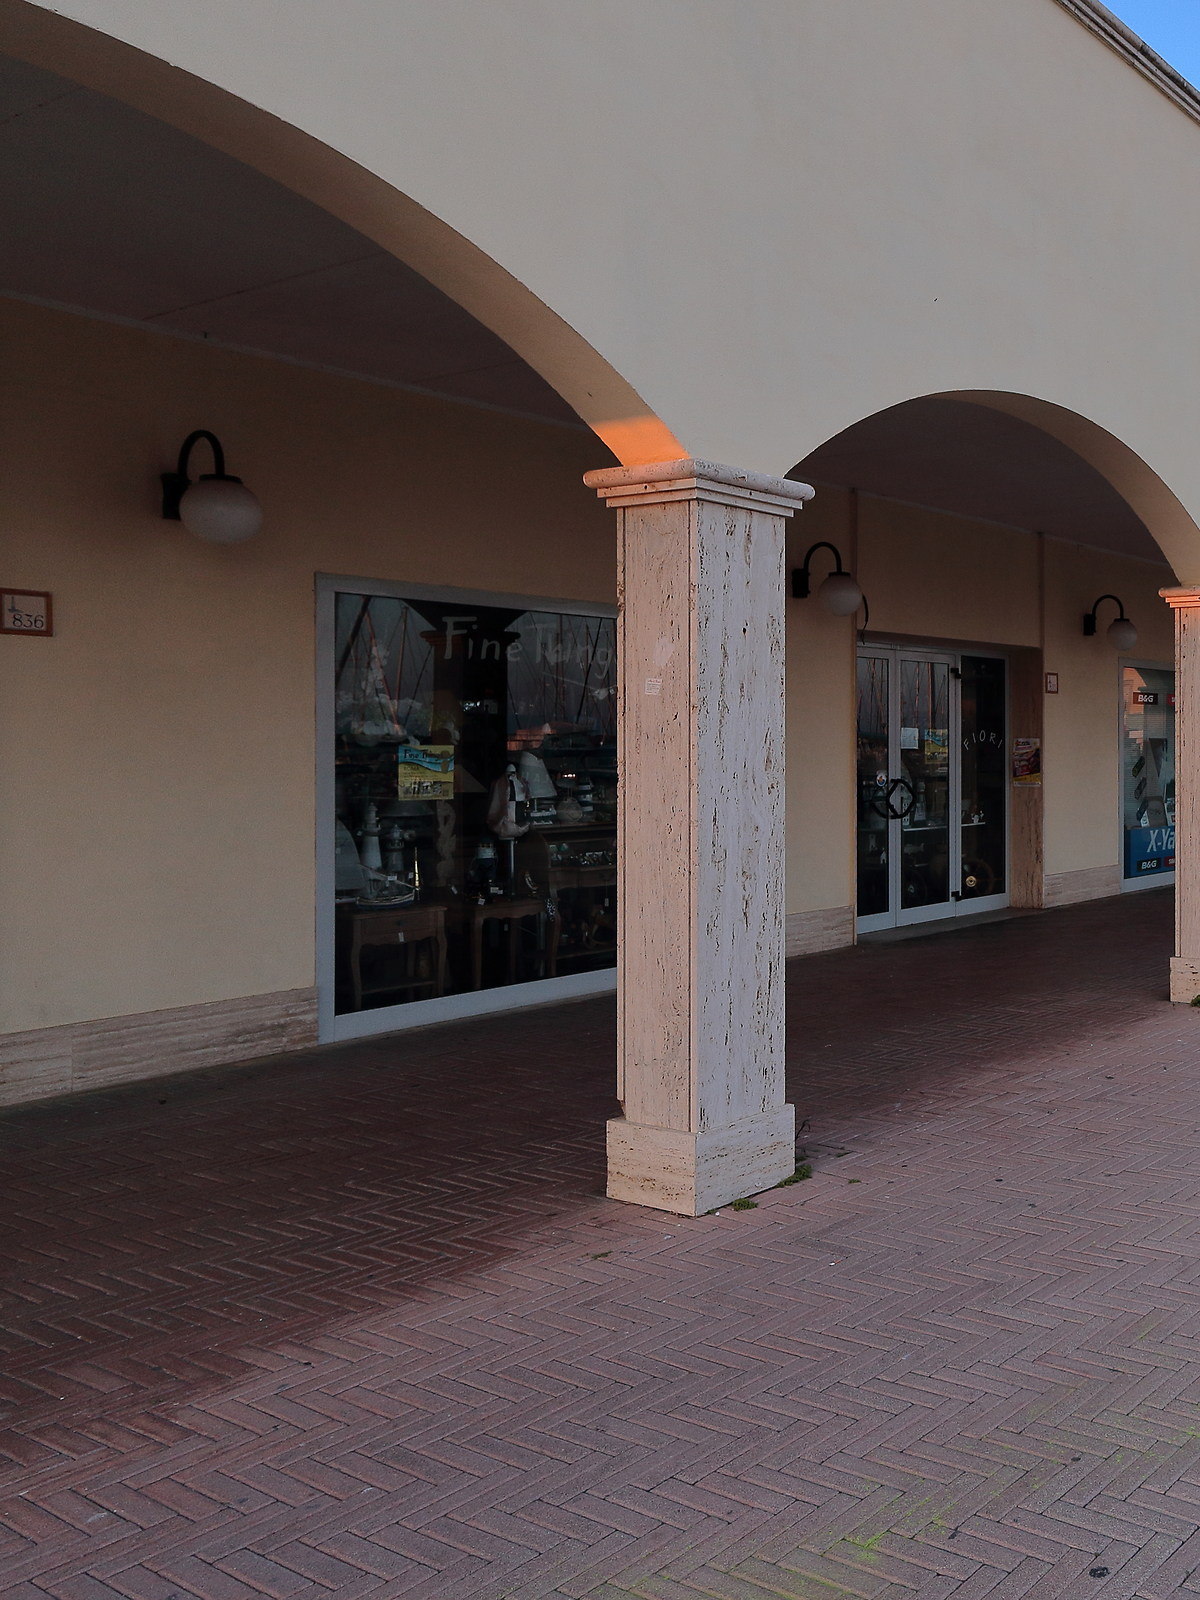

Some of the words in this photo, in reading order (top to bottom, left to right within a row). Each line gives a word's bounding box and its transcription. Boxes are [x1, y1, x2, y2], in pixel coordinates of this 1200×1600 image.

[12, 613, 44, 629] 836
[441, 616, 523, 661] Fine
[525, 622, 615, 679] Thing
[1137, 694, 1154, 703] B&G
[963, 729, 1003, 751] FIORI
[1146, 828, 1175, 853] X-Ya
[1141, 860, 1157, 869] B&G
